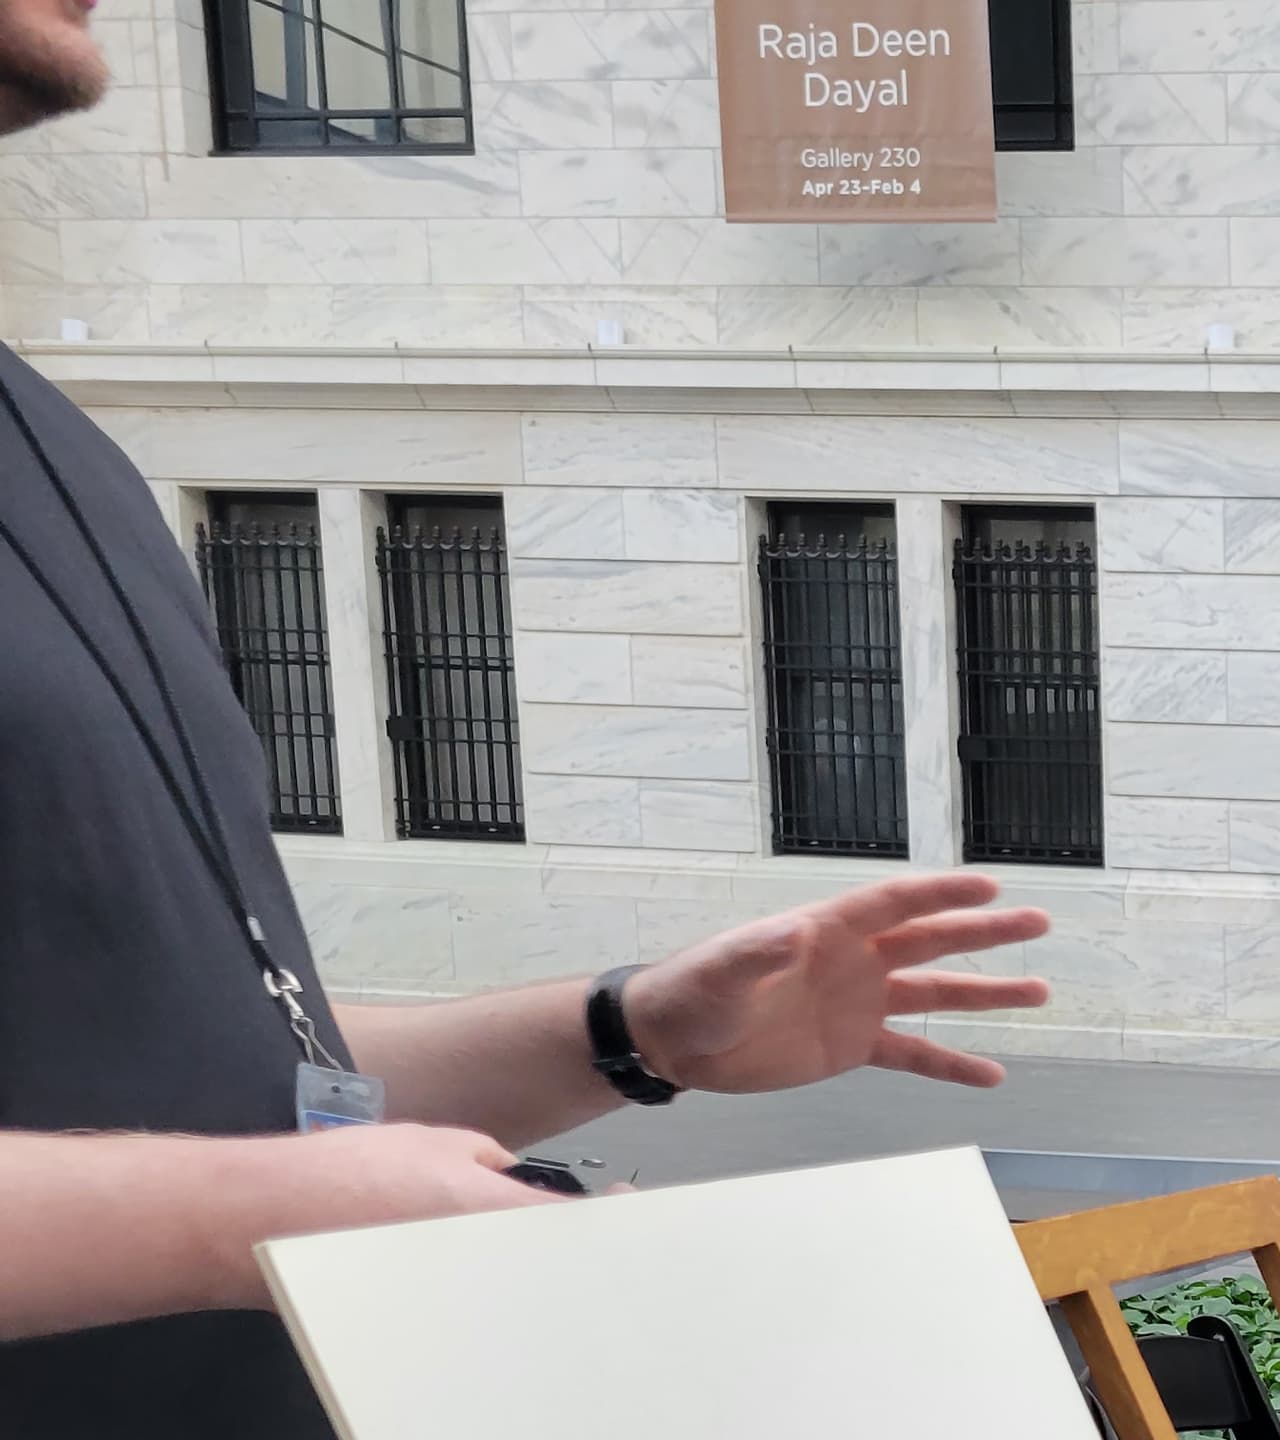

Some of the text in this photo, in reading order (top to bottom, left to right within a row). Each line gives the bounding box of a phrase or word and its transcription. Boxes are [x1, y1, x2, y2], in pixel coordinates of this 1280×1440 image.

[758, 22, 951, 65] Raja Deen
[804, 69, 909, 112] Dayal
[801, 147, 921, 171] Gallery 230
[802, 179, 834, 199] Apr
[910, 177, 922, 194] 4
